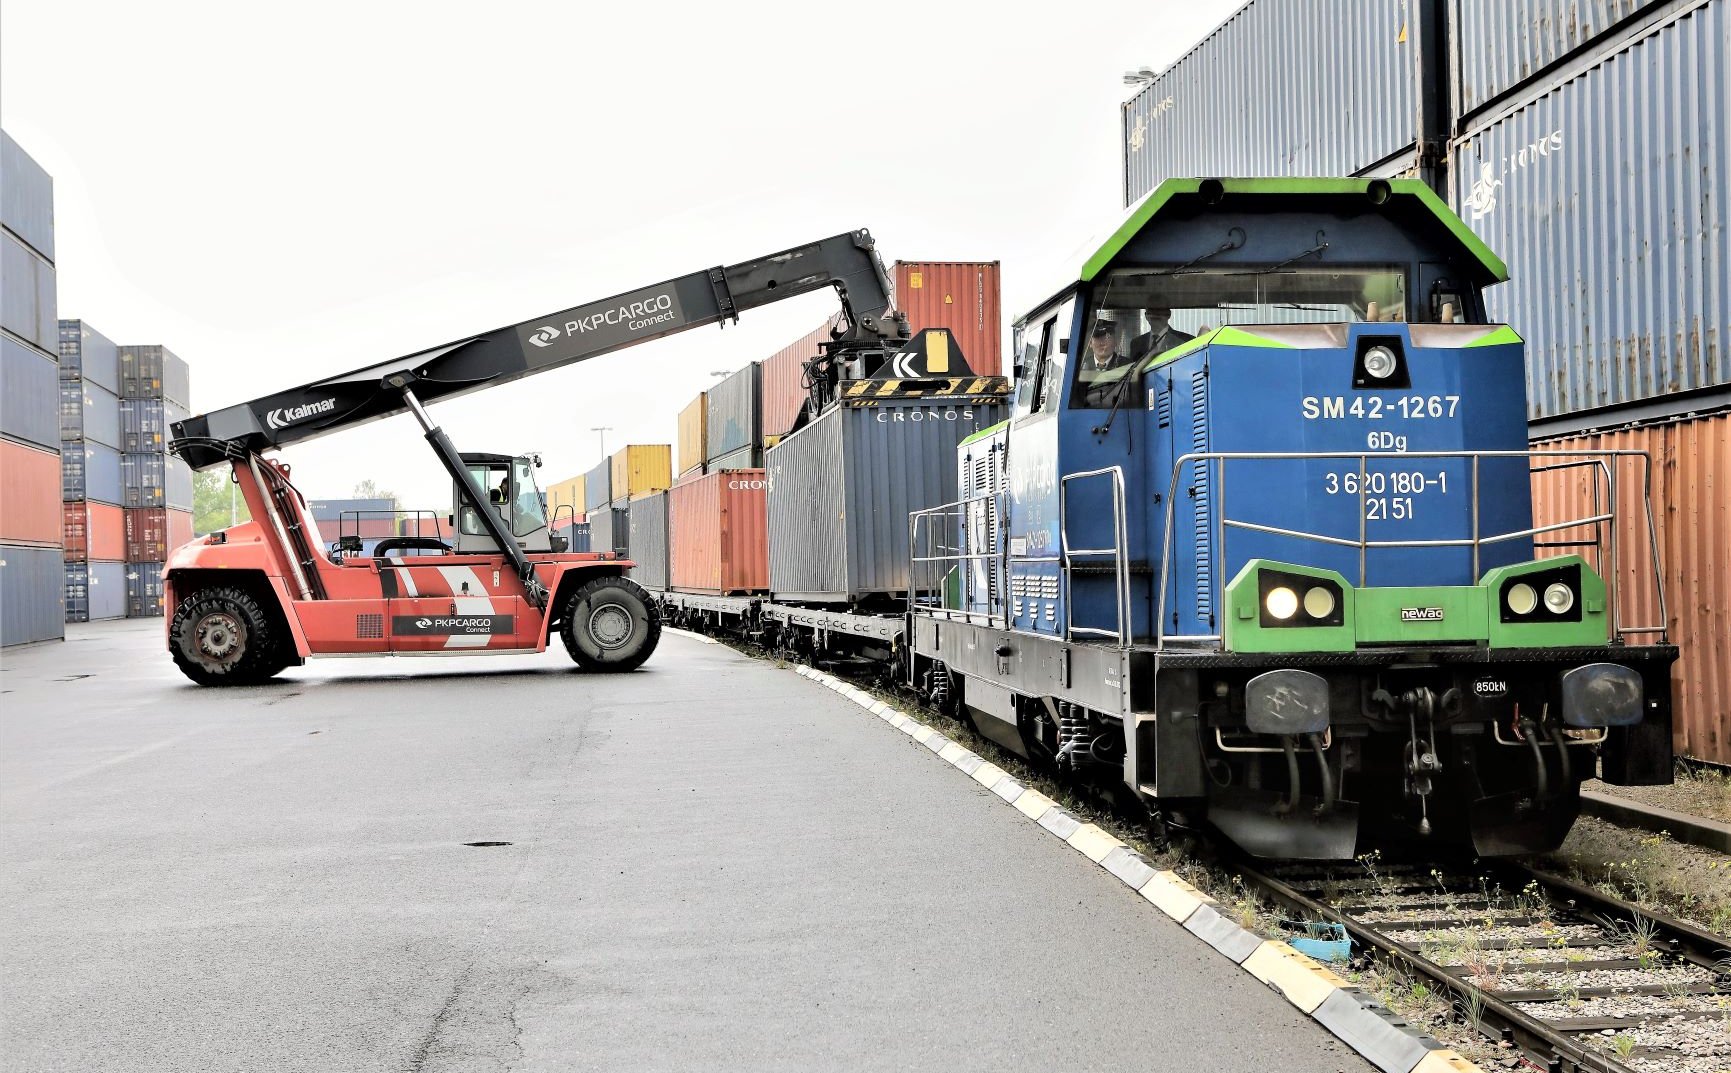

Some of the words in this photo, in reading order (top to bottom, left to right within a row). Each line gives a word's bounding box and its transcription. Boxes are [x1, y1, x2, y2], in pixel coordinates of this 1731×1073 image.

[1503, 130, 1562, 174] RONOS
[565, 294, 672, 337] PKPCARGO
[628, 310, 676, 331] Connect
[284, 398, 336, 422] Kalmar
[877, 411, 973, 422] CRONOS
[1302, 395, 1460, 419] SM42-1267
[1367, 431, 1407, 452] 6Dg
[1325, 473, 1339, 494] 3
[1476, 681, 1506, 692] 850kN
